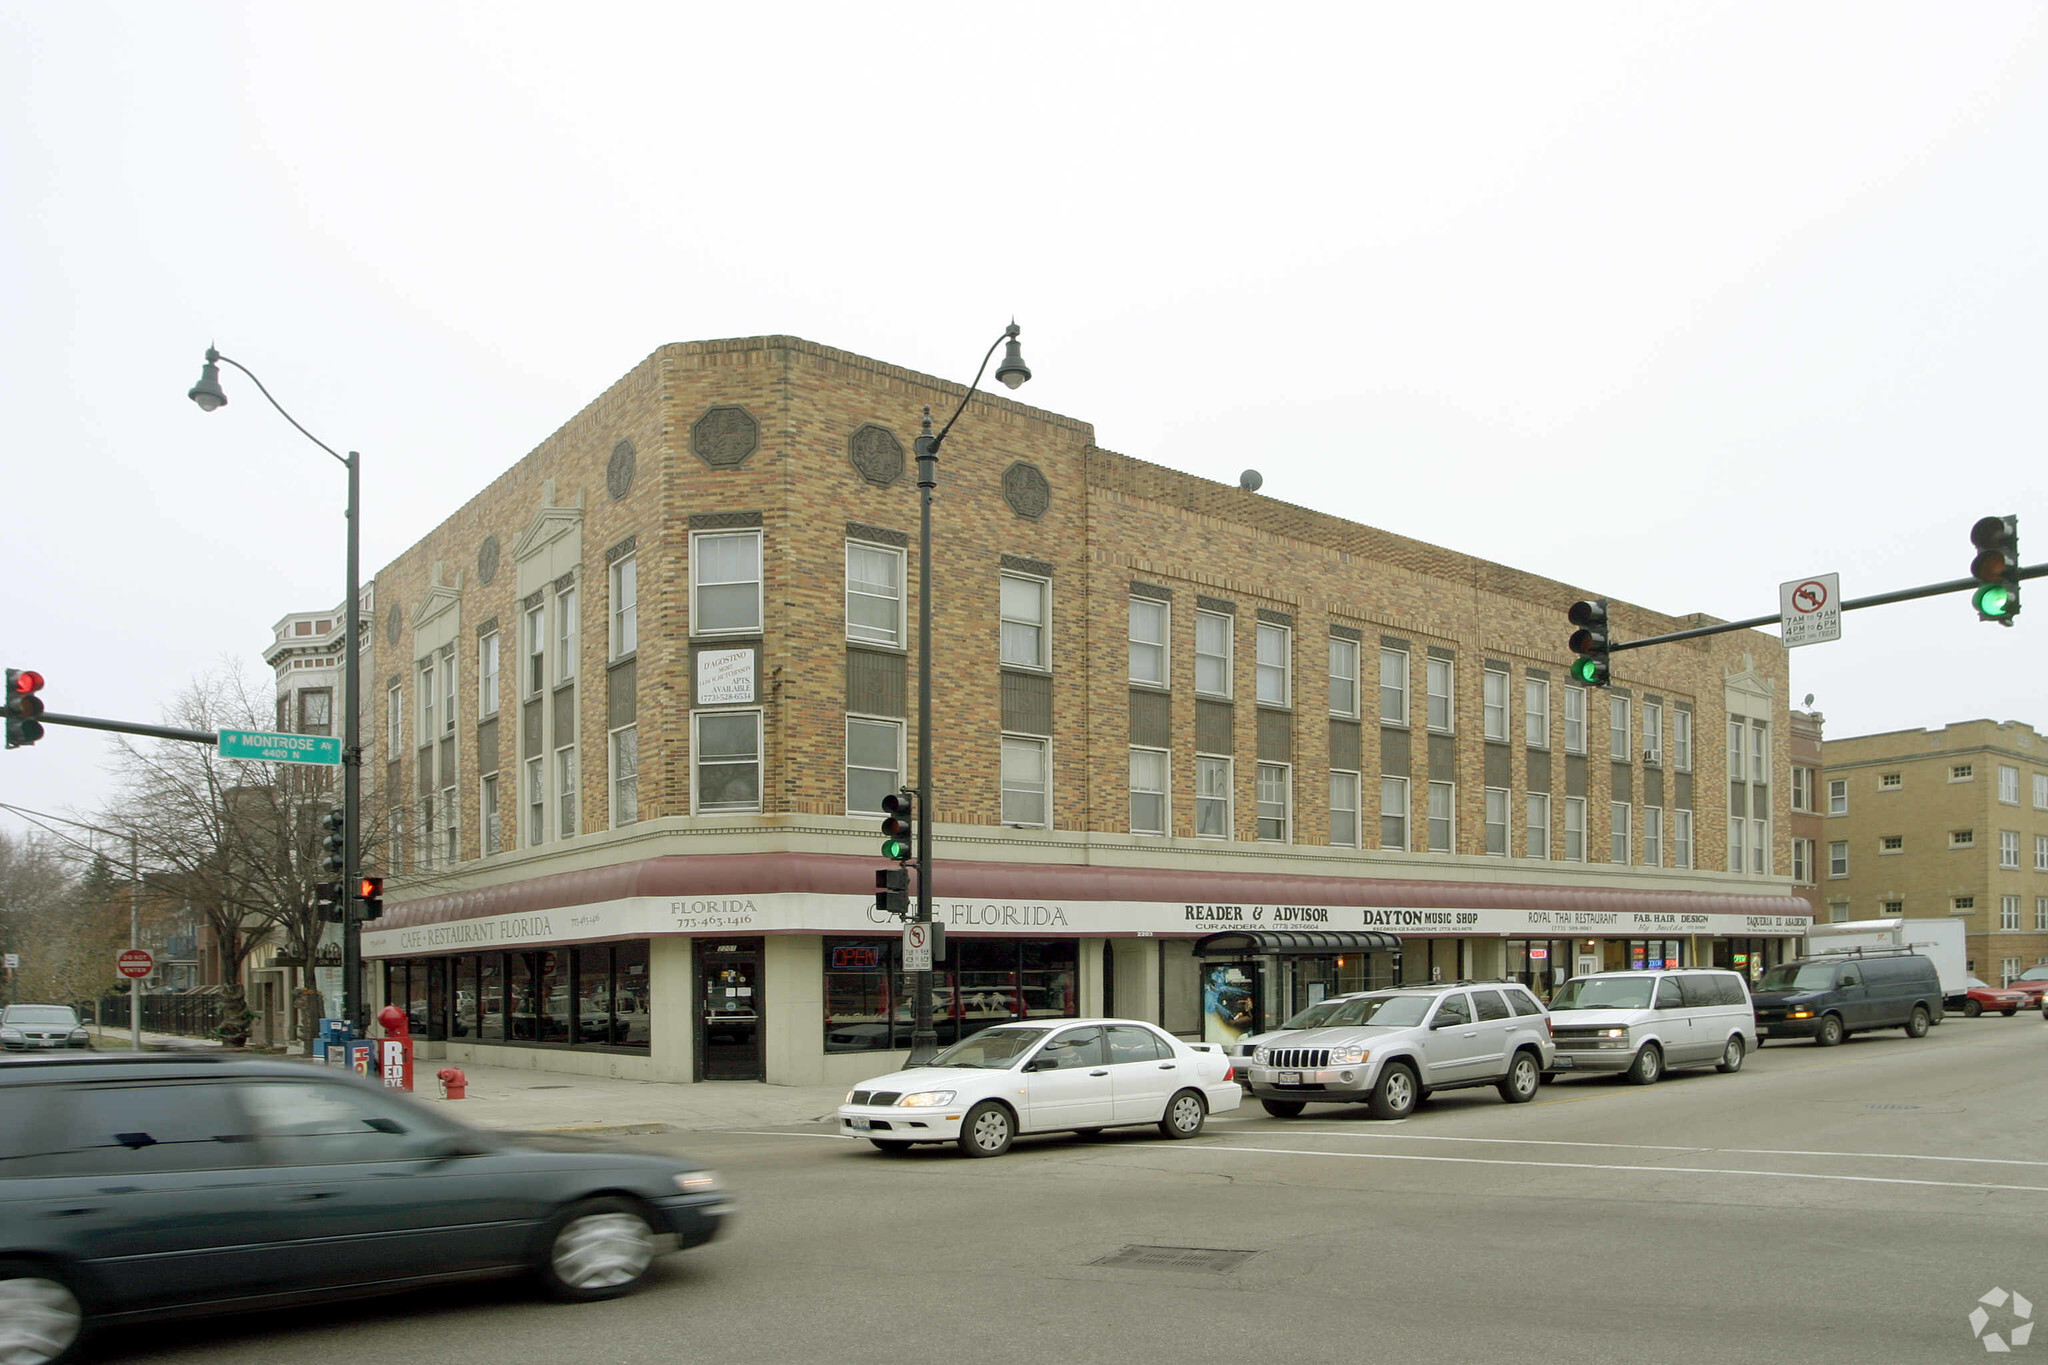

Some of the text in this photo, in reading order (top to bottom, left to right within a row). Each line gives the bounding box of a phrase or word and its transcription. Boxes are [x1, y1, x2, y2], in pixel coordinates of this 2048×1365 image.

[1816, 610, 1836, 620] 9AM
[1786, 625, 1806, 636] 4PM
[1816, 620, 1836, 631] 6PM
[1818, 629, 1836, 638] FRIDAY
[704, 651, 747, 670] D'AGOSTINO
[712, 685, 752, 694] AVAILABLE
[228, 734, 333, 750] W MONTROSE AV
[262, 749, 300, 759] 4400 N
[670, 900, 757, 914] FLORIDA
[1185, 906, 1328, 922] READER & ADVISOR
[951, 904, 1069, 926] FLORIDA
[1363, 910, 1478, 925] DAYTON MUSIC SHOP
[1528, 912, 1618, 924] ROYAL THAI RESTAURANT
[1654, 914, 1675, 922] HAIR
[1681, 915, 1708, 923] DESIGN
[1746, 917, 1772, 927] TAQUERIA
[1776, 918, 1782, 926] EL
[400, 916, 552, 948] CAFE RESTAURANT FLORIDA
[835, 948, 877, 966] OPEN
[384, 1040, 403, 1066] R
[384, 1079, 403, 1088] EYE
